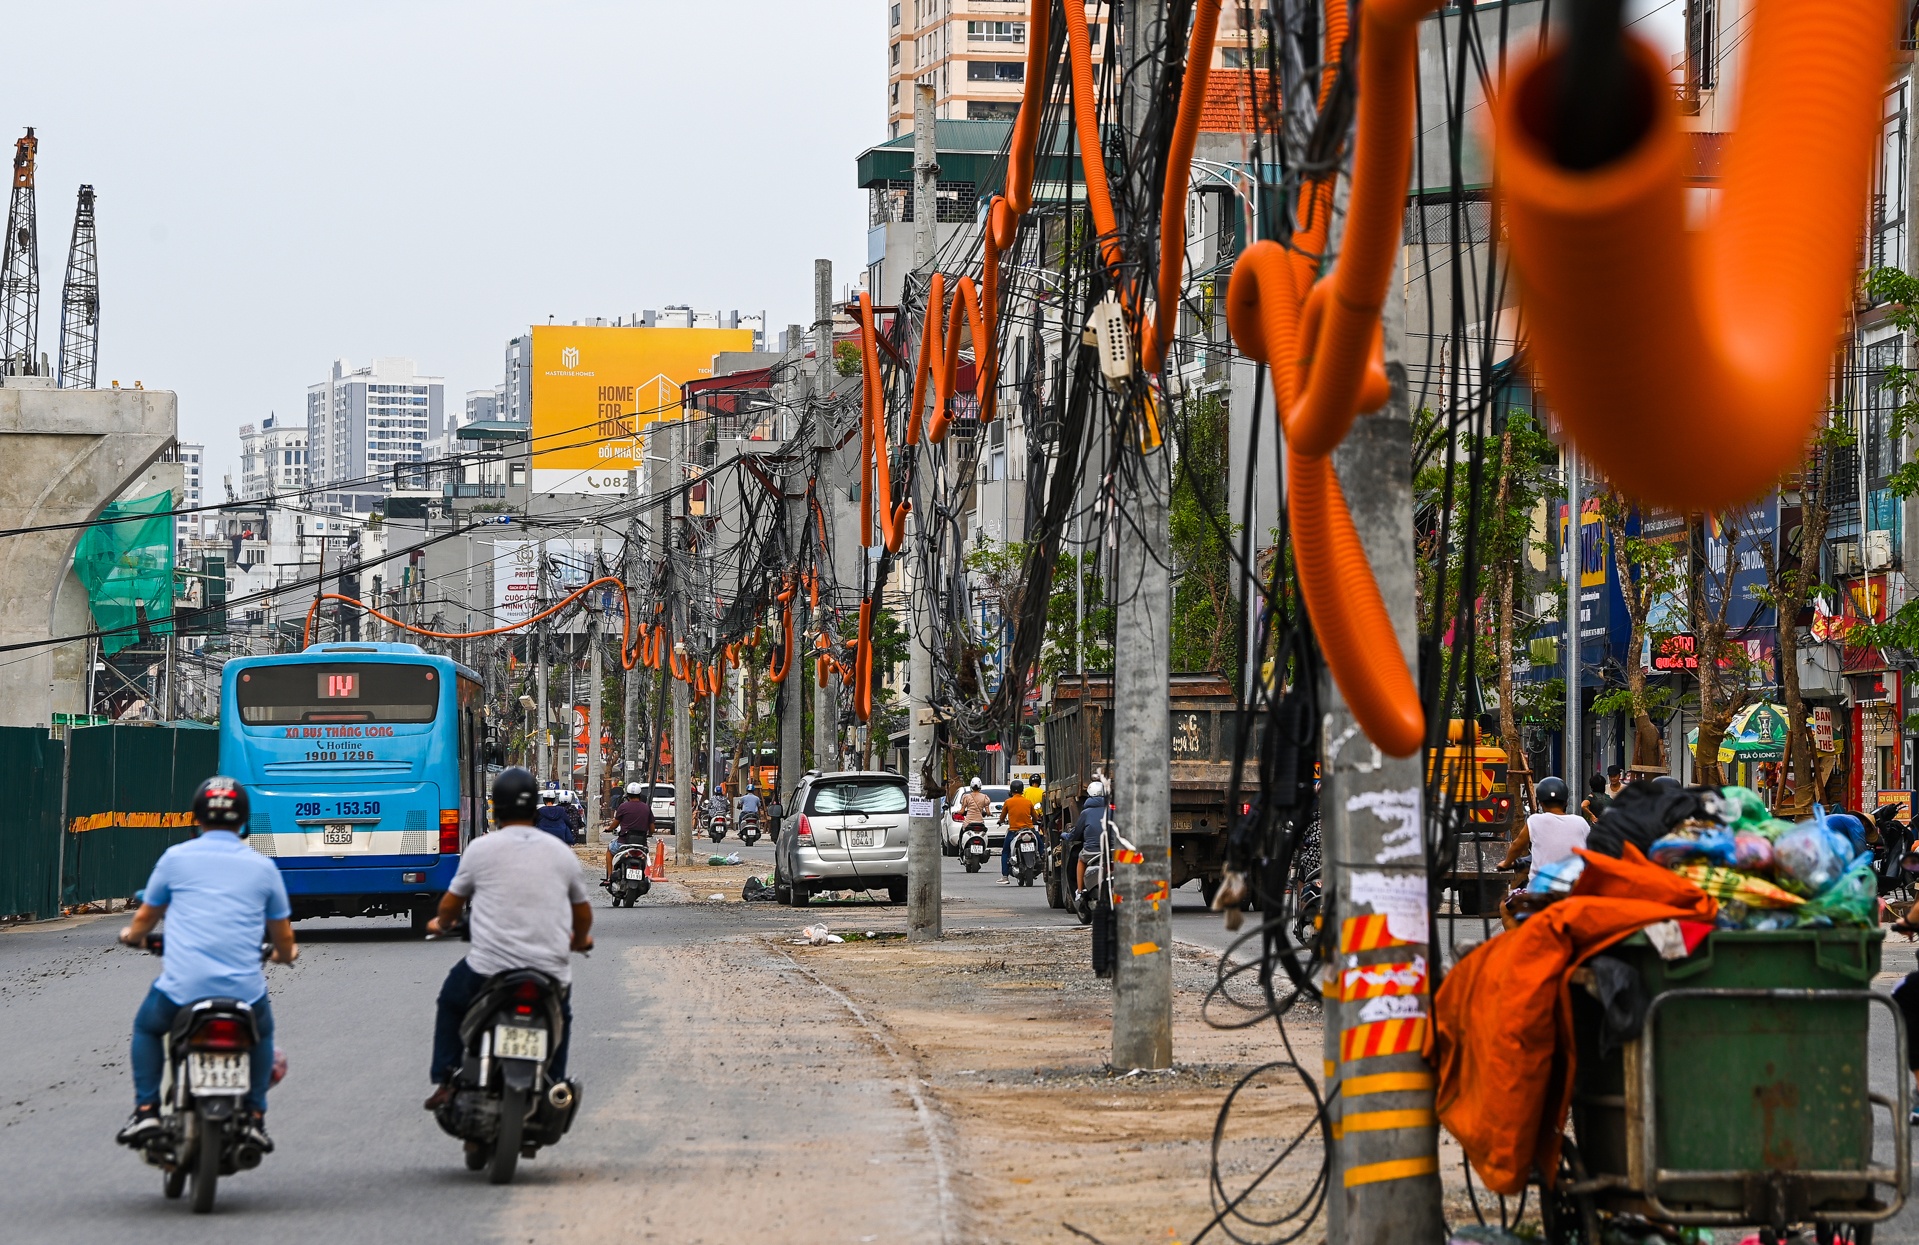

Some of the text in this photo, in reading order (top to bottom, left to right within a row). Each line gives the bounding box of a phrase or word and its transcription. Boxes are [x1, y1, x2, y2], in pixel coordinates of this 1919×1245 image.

[598, 386, 633, 401] HOME
[598, 404, 621, 418] FOR
[598, 421, 633, 437] HOME
[614, 446, 632, 458] NHÀ
[1815, 710, 1831, 722] BÁN
[303, 727, 322, 738] BUS
[325, 725, 362, 738] THĂNG
[365, 726, 394, 737] LONG
[1816, 724, 1832, 736] SIM
[327, 741, 362, 750] Hotline
[1818, 735, 1833, 751] THẺ
[305, 751, 374, 761] 1900 1296
[295, 802, 321, 816] 29B
[335, 801, 380, 815] 153.50
[330, 825, 346, 834] 29B
[326, 834, 351, 843] 153.50
